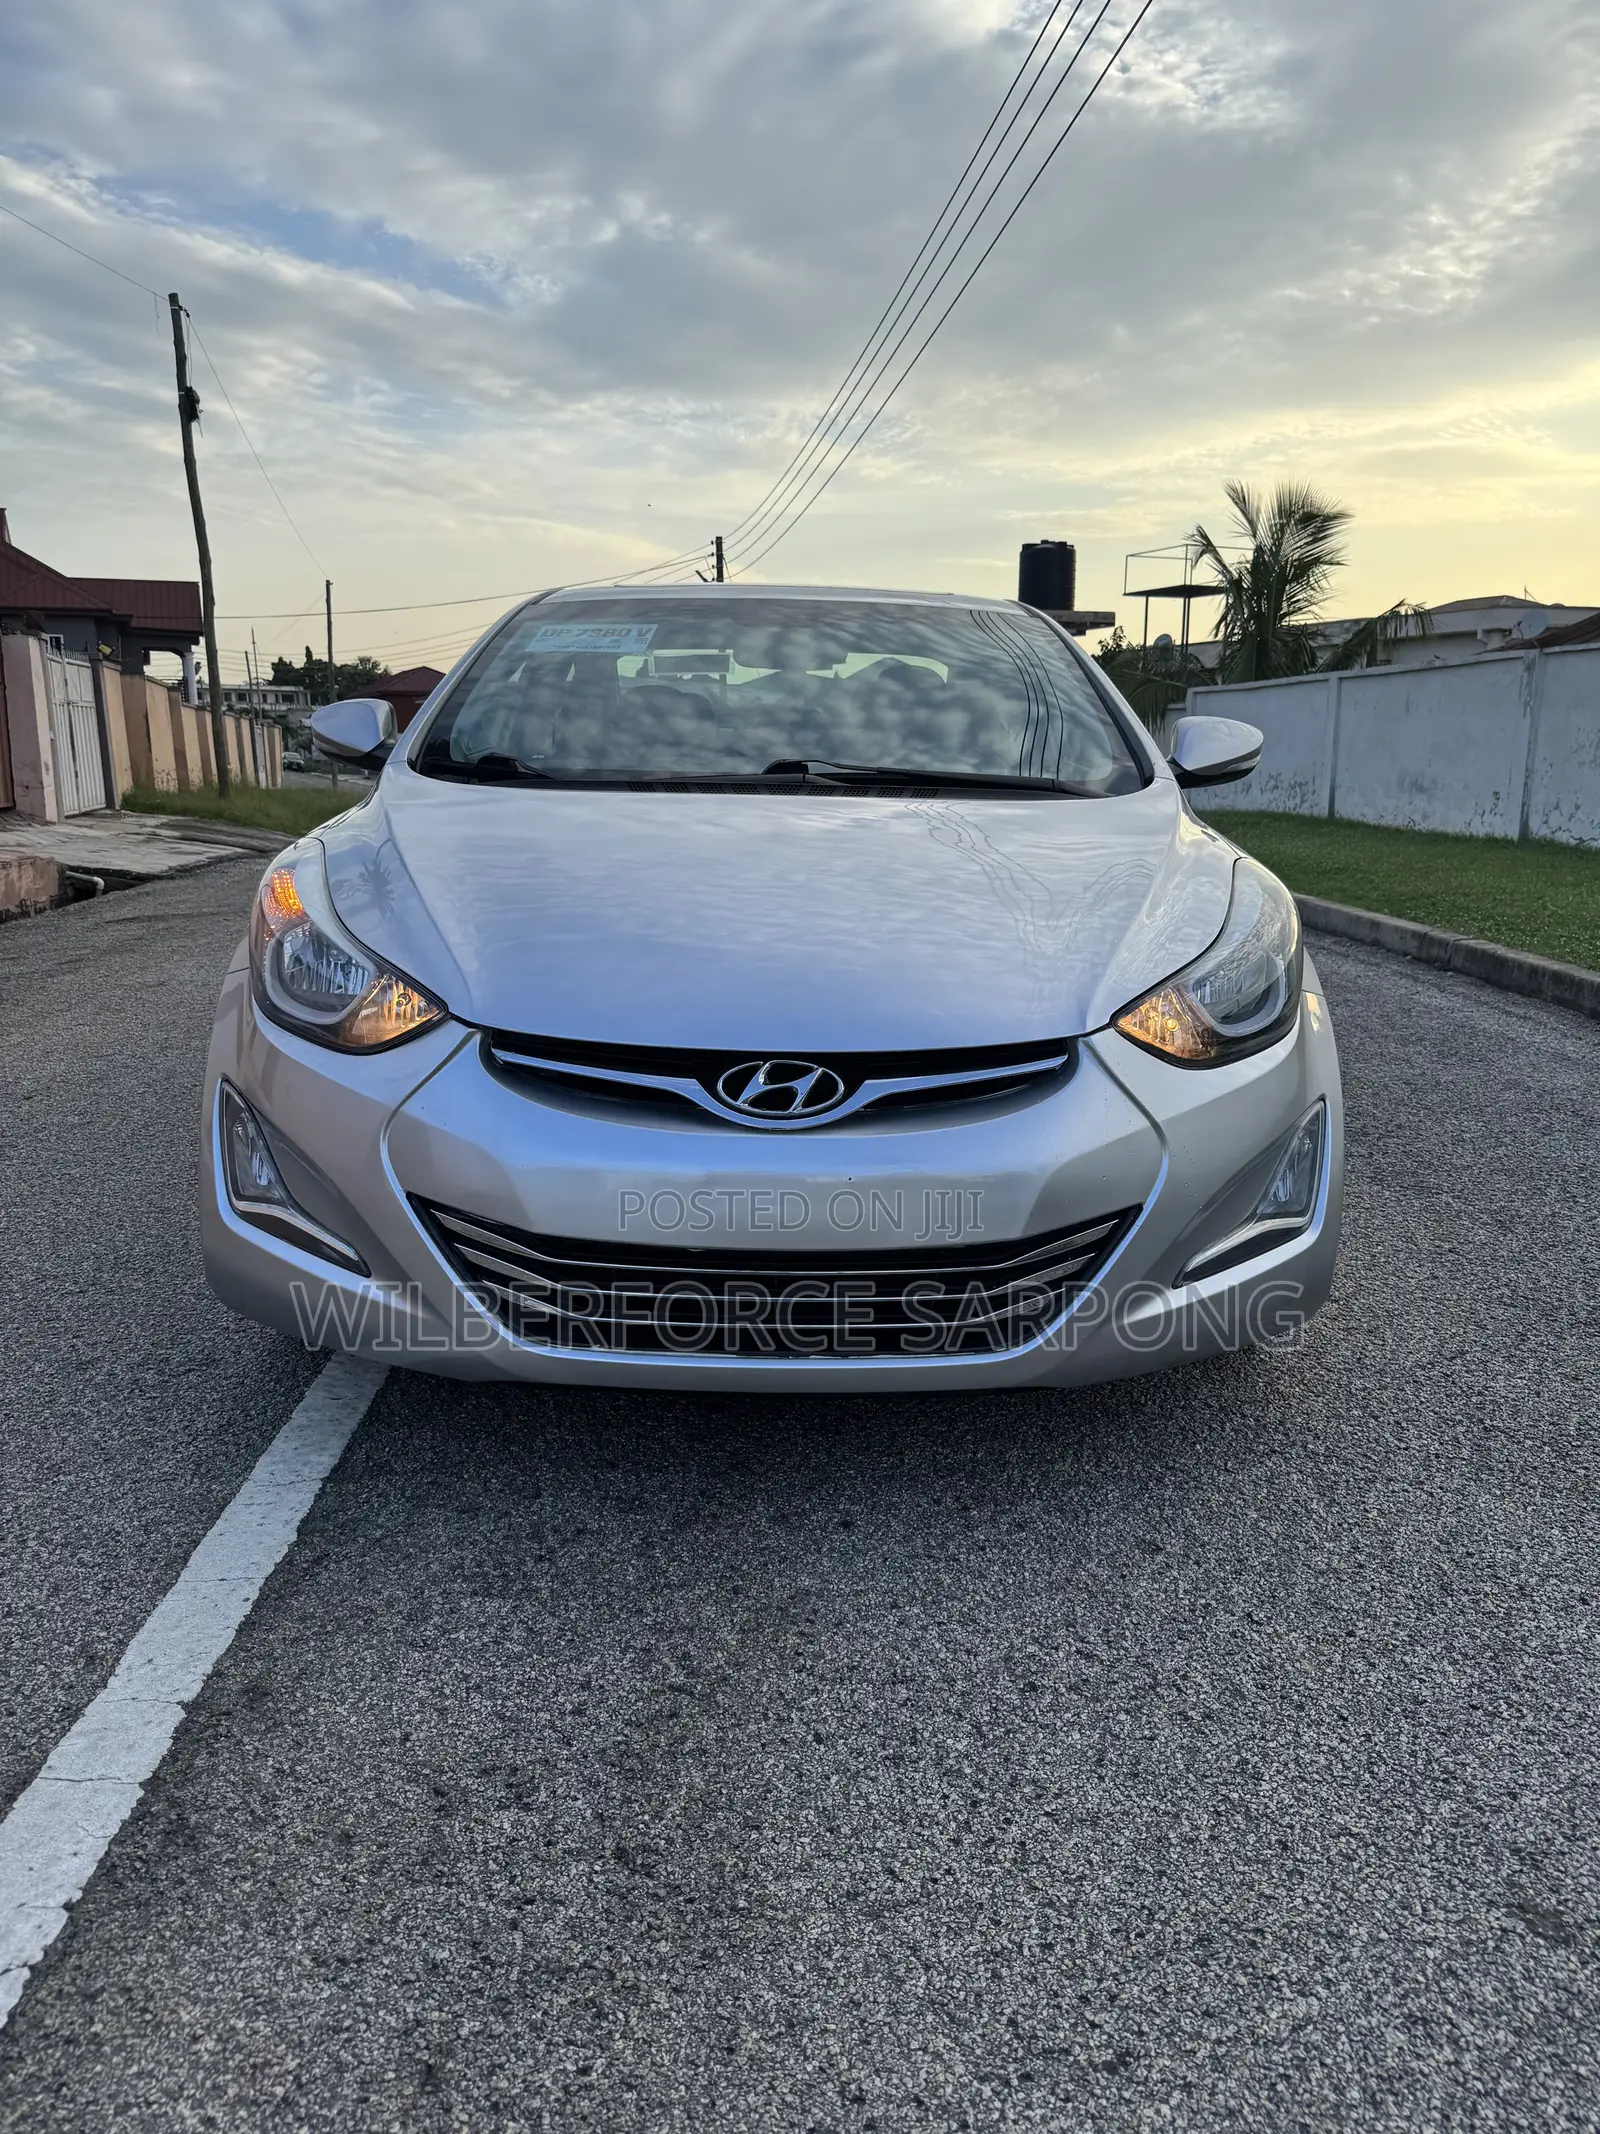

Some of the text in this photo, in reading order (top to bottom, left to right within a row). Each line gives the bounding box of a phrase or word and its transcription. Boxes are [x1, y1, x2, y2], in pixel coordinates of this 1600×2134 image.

[540, 627, 653, 638] DP 7380 V
